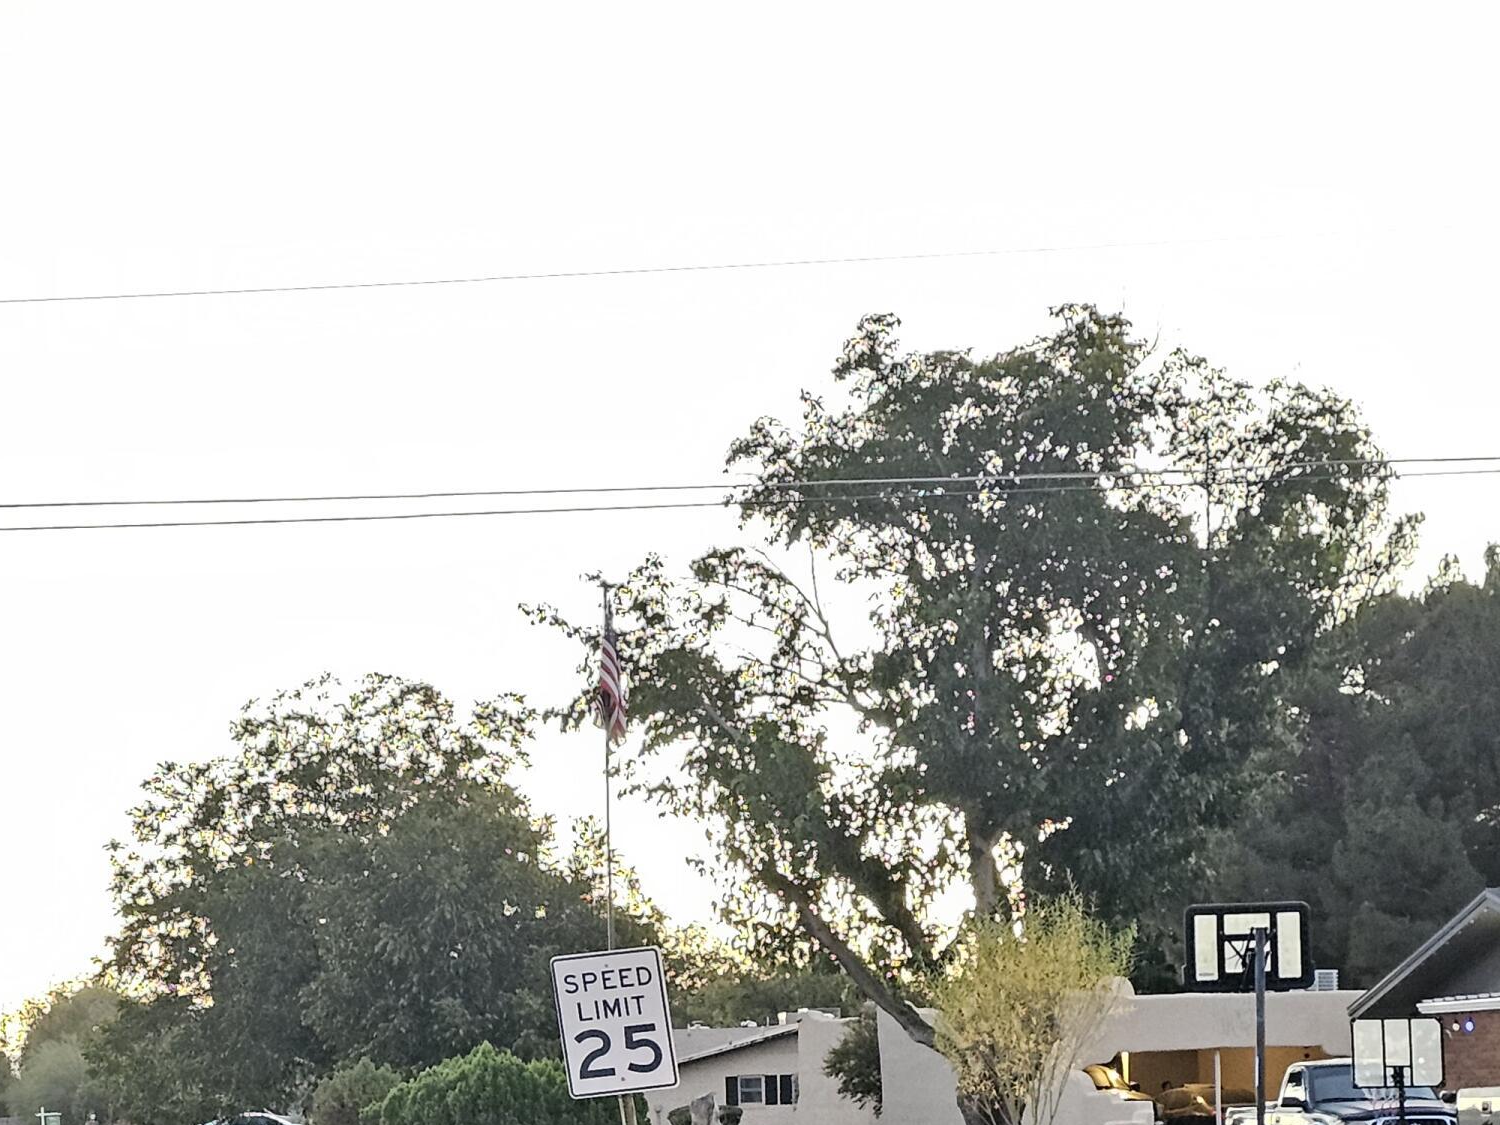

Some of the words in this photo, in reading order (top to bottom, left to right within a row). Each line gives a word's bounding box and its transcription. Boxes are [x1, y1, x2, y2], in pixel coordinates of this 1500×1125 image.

[563, 966, 652, 994] SPEED
[576, 995, 645, 1022] LIMIT
[574, 1023, 663, 1080] 25
